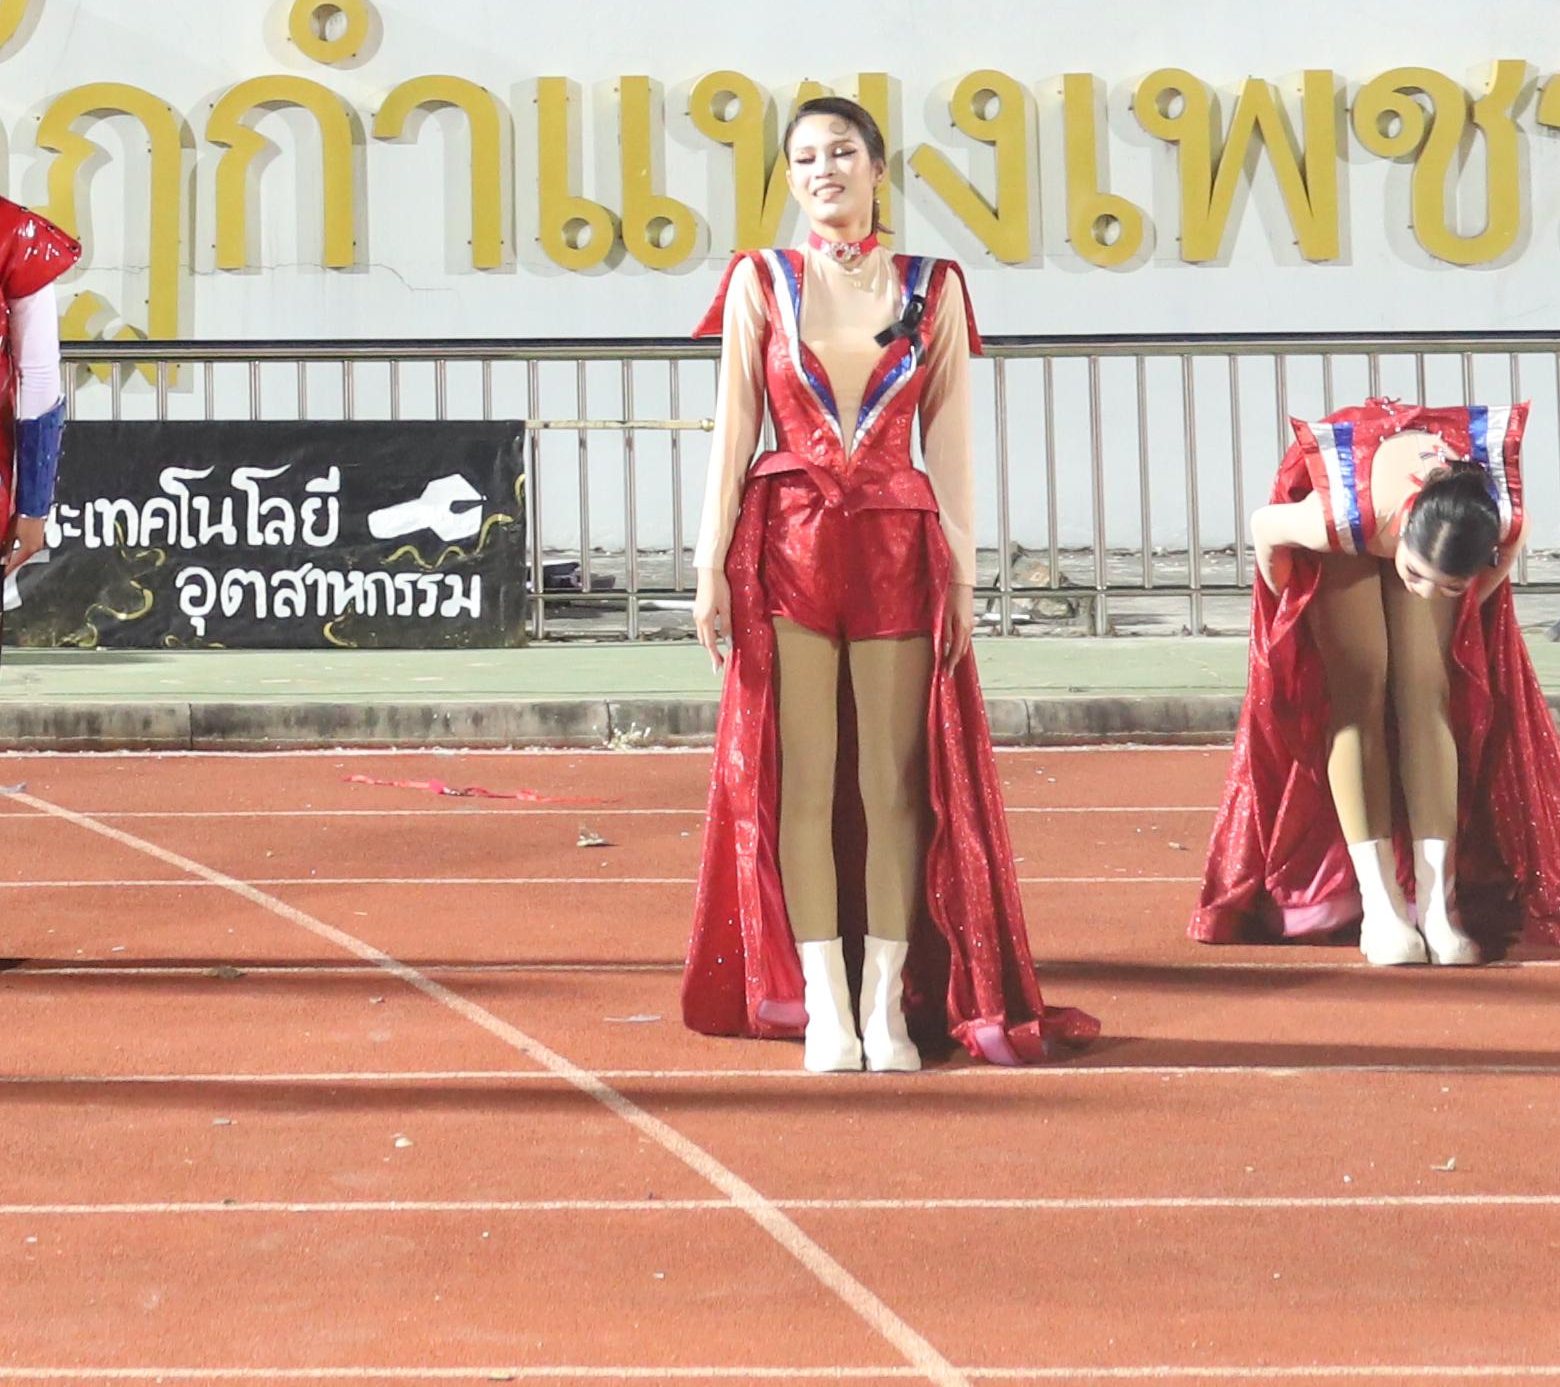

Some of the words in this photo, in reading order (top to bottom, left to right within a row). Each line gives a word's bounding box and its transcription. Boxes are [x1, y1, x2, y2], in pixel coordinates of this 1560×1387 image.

[43, 464, 340, 549] ะเทคโนโลยี
[176, 562, 482, 637] อุตสาหกรรม
